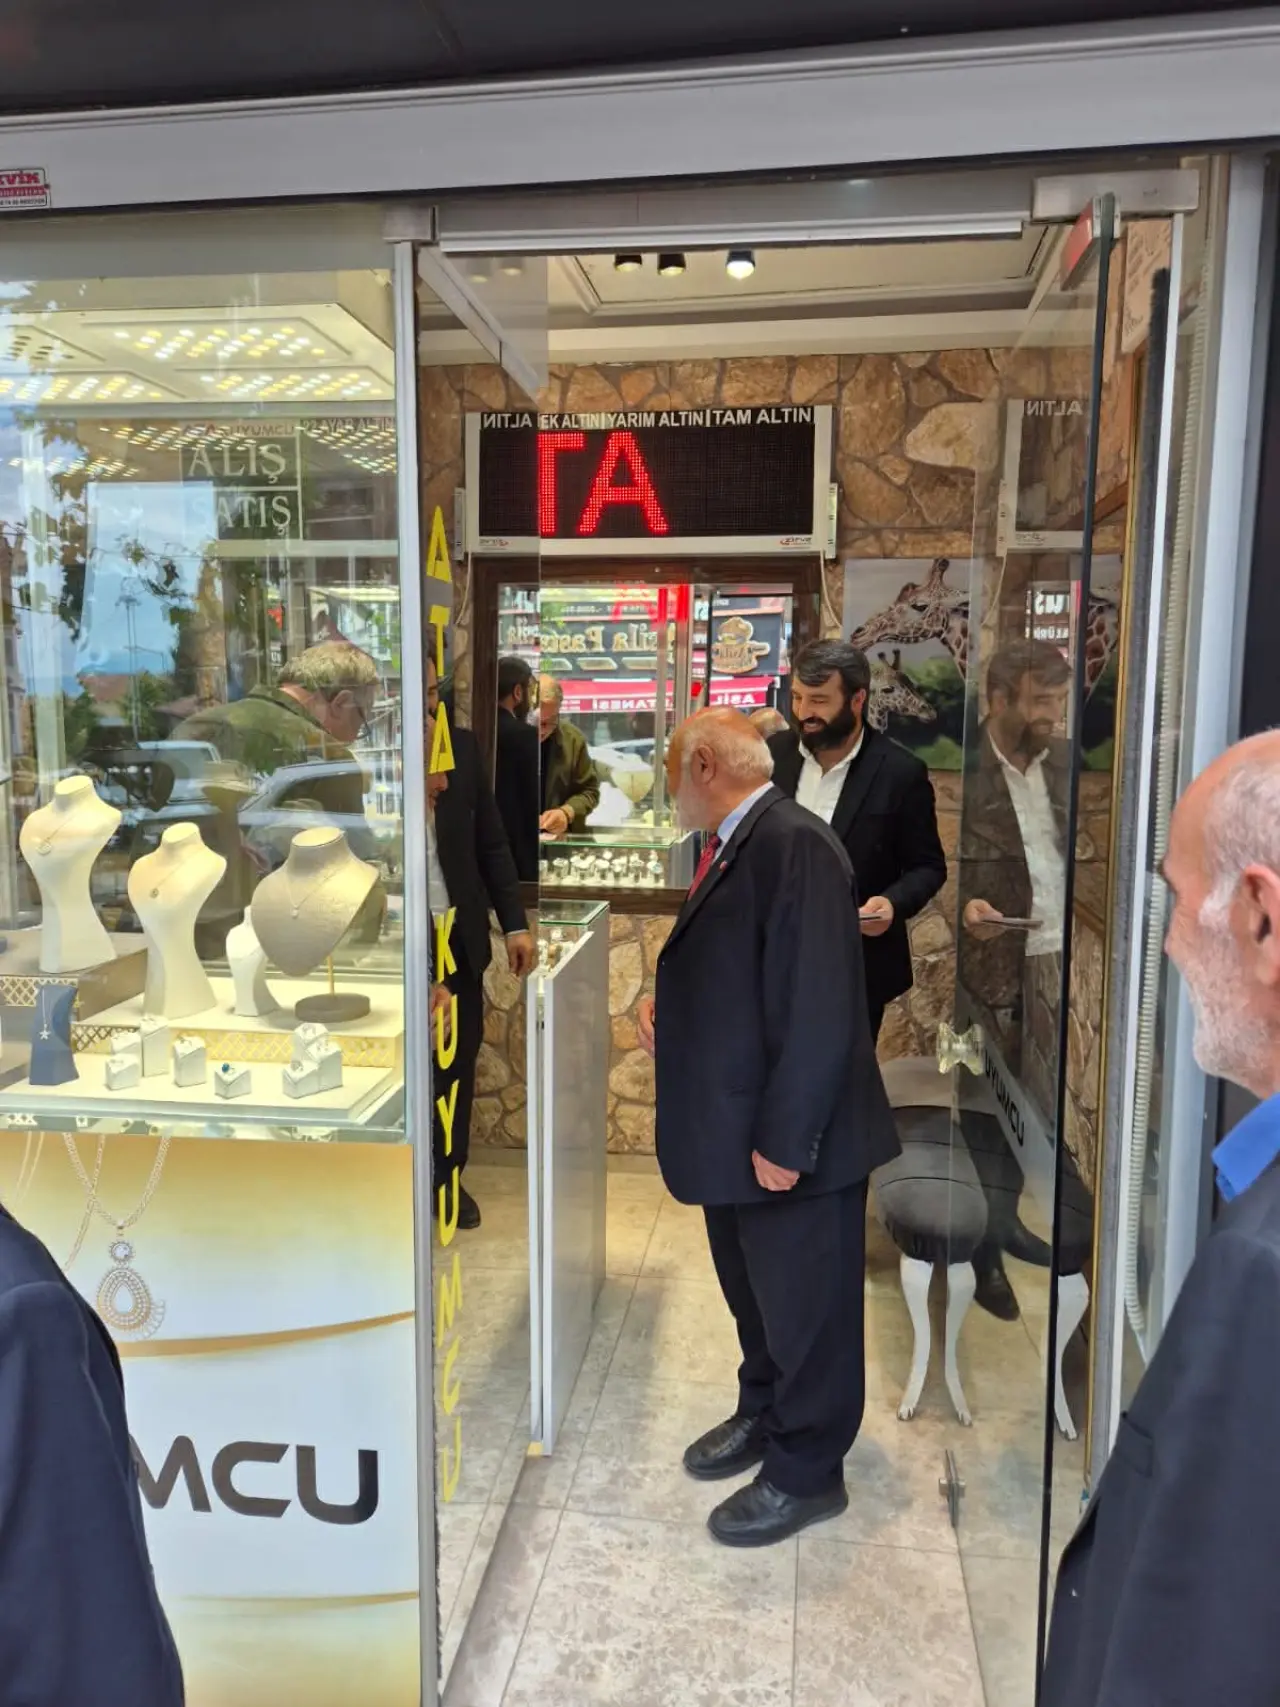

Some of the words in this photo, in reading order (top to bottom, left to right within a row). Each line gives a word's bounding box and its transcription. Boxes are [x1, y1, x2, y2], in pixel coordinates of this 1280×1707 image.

[561, 413, 599, 429] ALTIN
[607, 412, 656, 428] YARIM
[658, 411, 703, 427] ALTIN
[713, 409, 751, 426] TAM
[756, 407, 812, 425] ALTIN
[188, 442, 287, 484] ALIŞ
